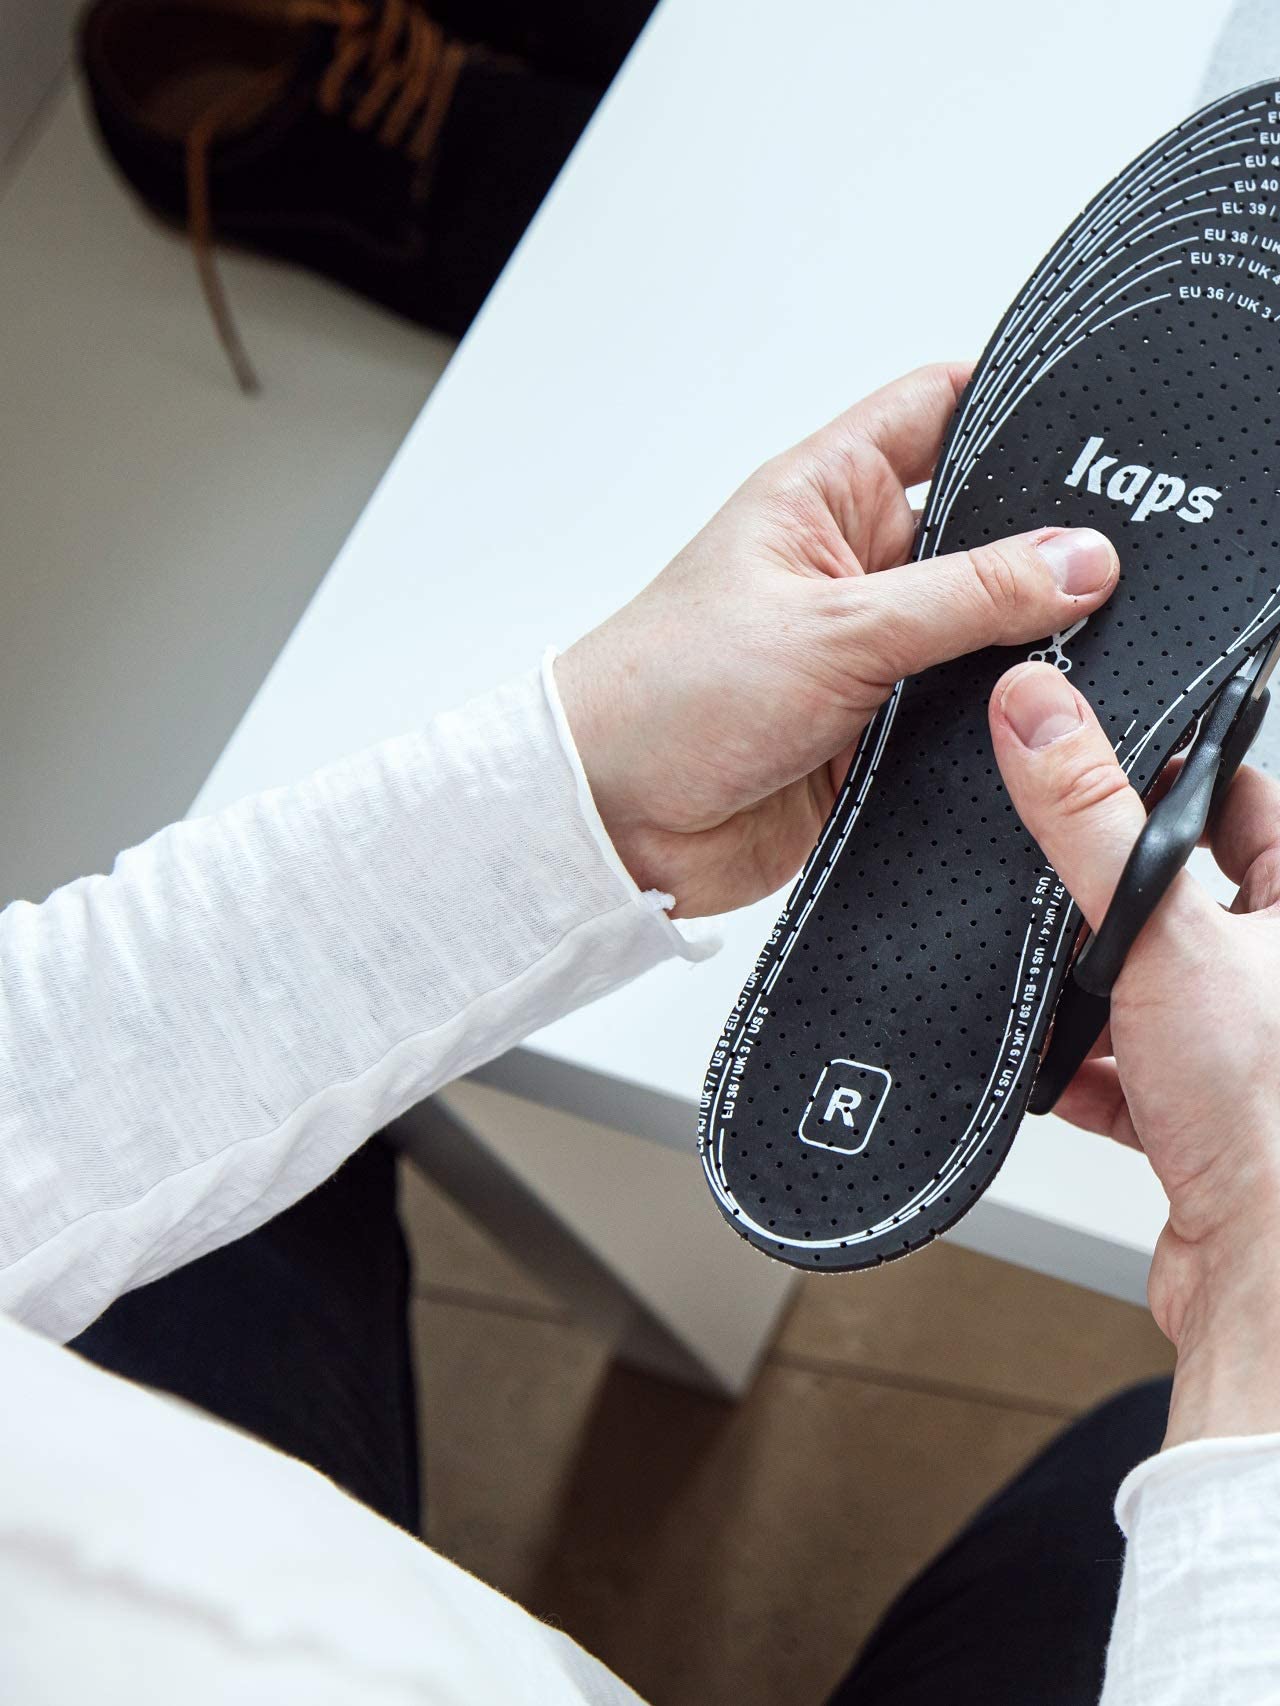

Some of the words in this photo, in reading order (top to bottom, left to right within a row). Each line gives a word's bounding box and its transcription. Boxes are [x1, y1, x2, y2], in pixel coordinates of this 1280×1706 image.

[1260, 132, 1280, 145] EU
[1245, 155, 1267, 168] EU
[1234, 180, 1256, 193] EU
[1261, 179, 1279, 192] 40
[1249, 202, 1266, 215] 39
[1204, 228, 1226, 241] EU
[1231, 231, 1248, 244] 38
[1191, 252, 1212, 265] EU
[1218, 253, 1235, 266] 37
[1248, 260, 1271, 279] UK
[1179, 286, 1201, 298] EU
[1207, 286, 1224, 300] 36
[1237, 294, 1260, 313] UK
[1261, 307, 1271, 318] 3
[1064, 436, 1222, 523] kaps
[1036, 877, 1051, 894] US
[1053, 886, 1065, 899] 37
[1032, 897, 1043, 905] 5
[1043, 908, 1056, 925] UK
[1032, 948, 1045, 965] US
[1023, 984, 1036, 1002] EU
[757, 1006, 769, 1015] 5
[1019, 1004, 1031, 1018] 39
[747, 1017, 763, 1034] US
[740, 1046, 751, 1054] 3
[1010, 1049, 1020, 1057] 6
[700, 1090, 713, 1108] UK
[711, 1050, 726, 1067] US
[726, 1013, 740, 1031] EU
[733, 1056, 748, 1075] UK
[999, 1069, 1013, 1087] US
[726, 1084, 740, 1098] 36
[994, 1089, 1004, 1097] 8
[721, 1101, 735, 1119] EU
[823, 1087, 862, 1127] R
